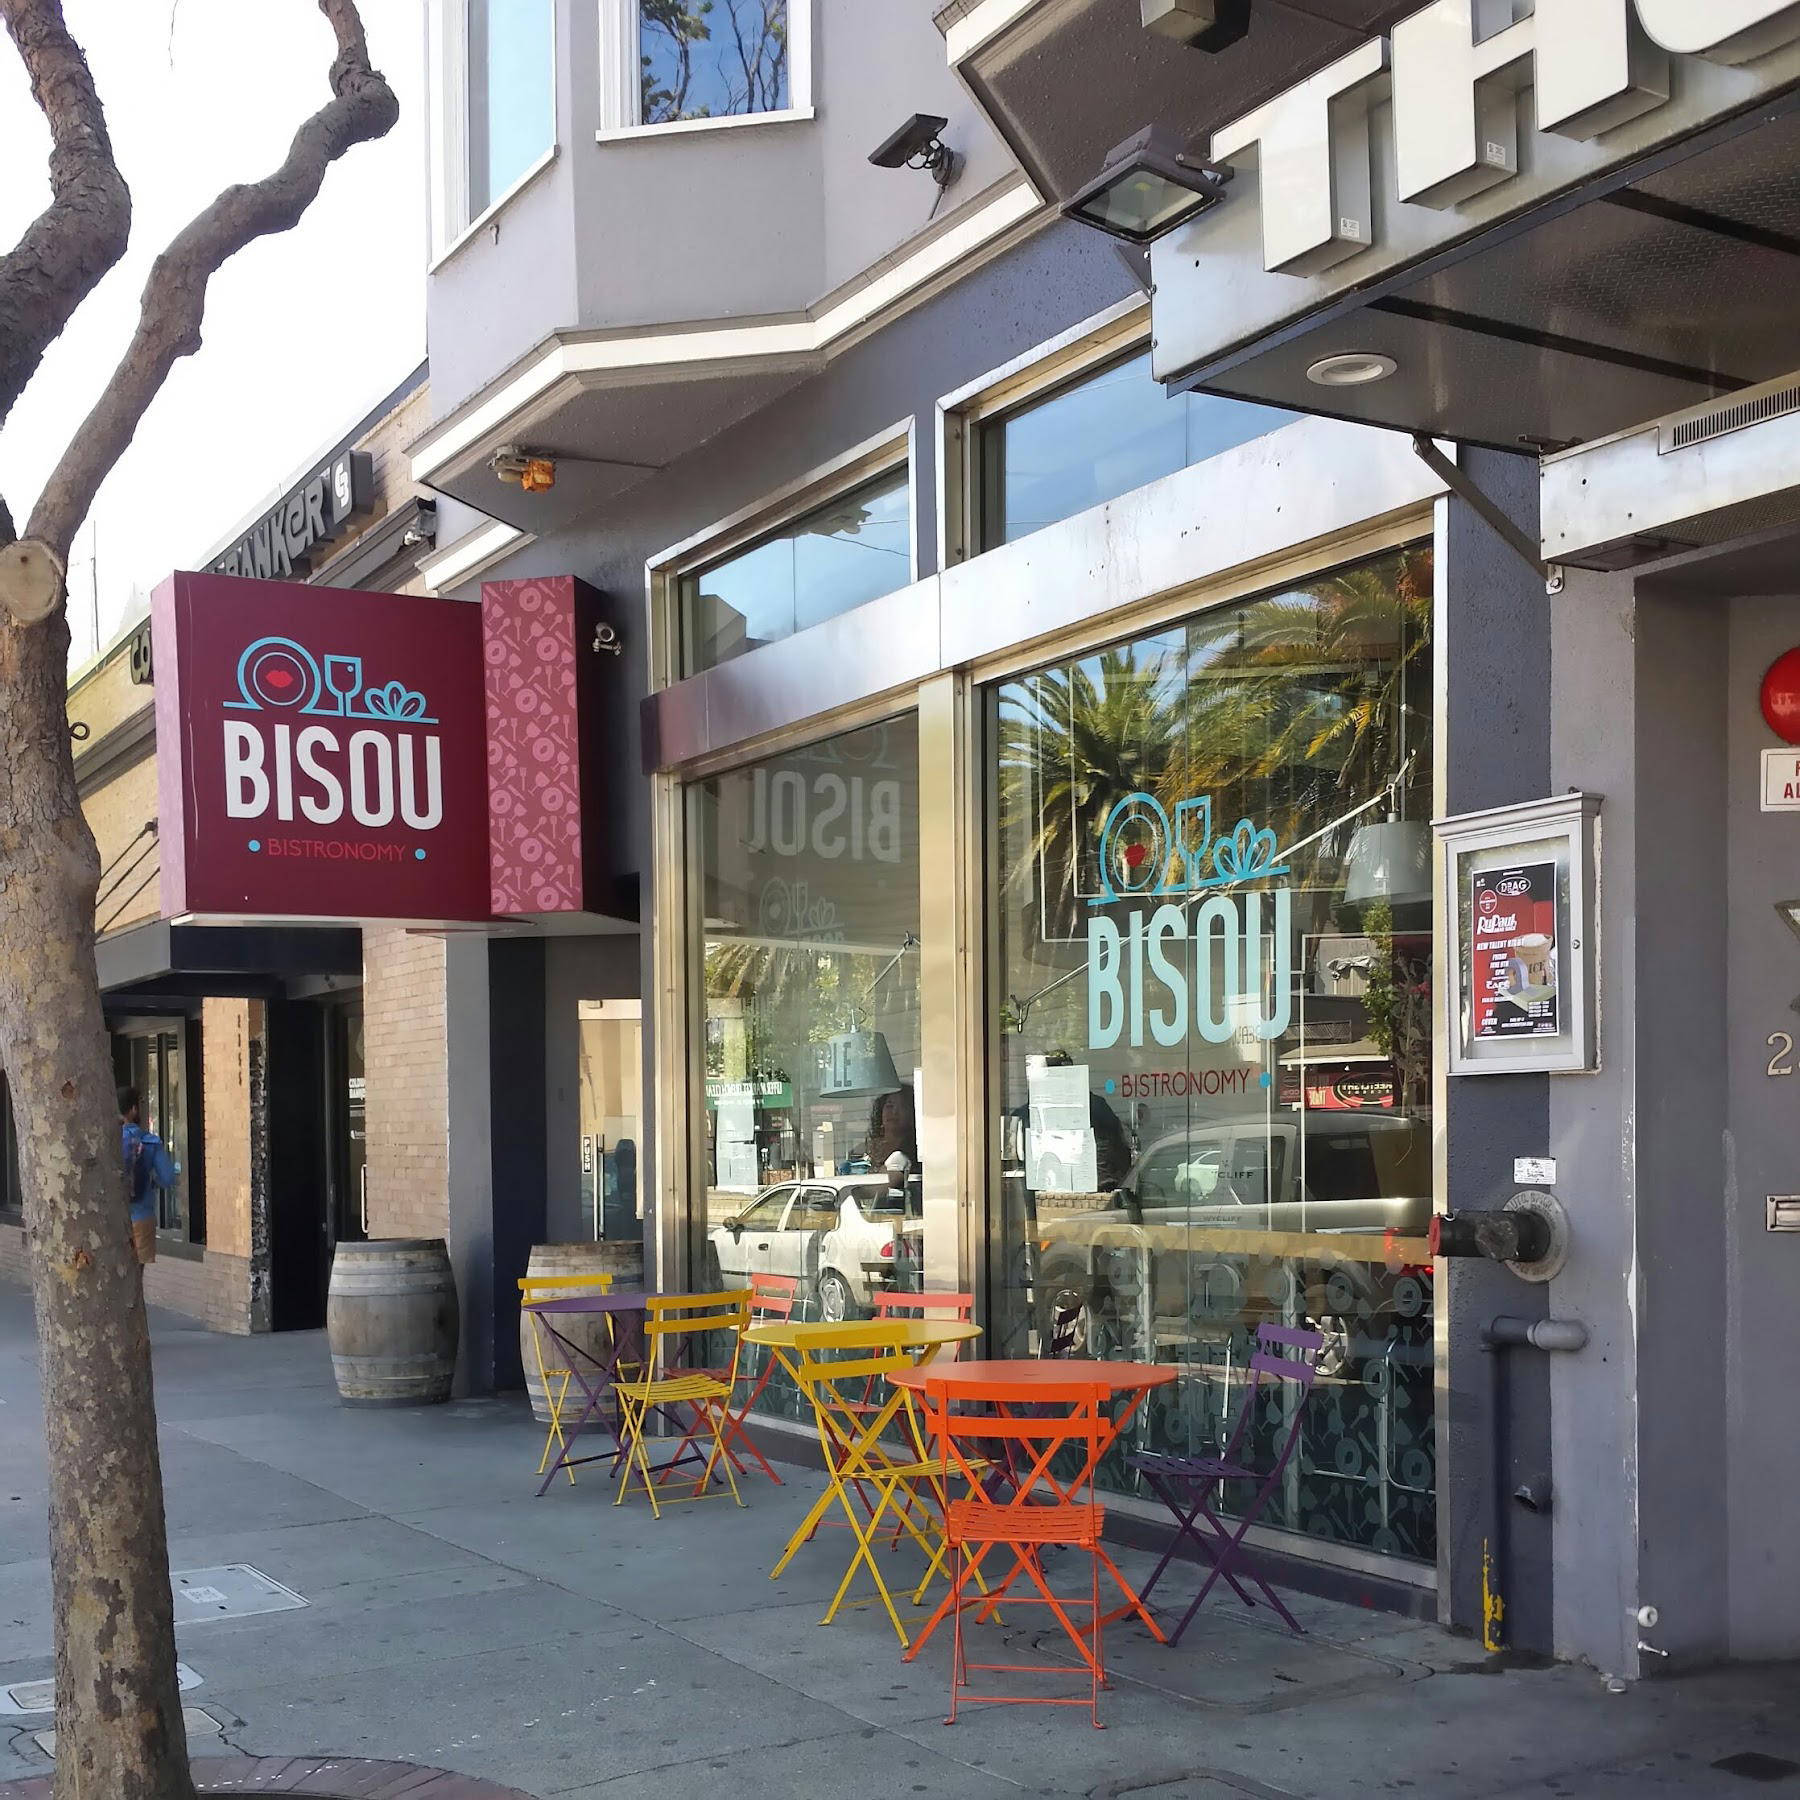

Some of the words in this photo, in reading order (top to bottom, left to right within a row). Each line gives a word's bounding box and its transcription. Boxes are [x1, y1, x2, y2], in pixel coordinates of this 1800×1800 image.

[1210, 0, 1800, 274] TH
[223, 719, 444, 832] BISOU
[267, 836, 407, 863] BISTRONOMY
[1086, 887, 1292, 1051] BISOU
[1121, 1068, 1251, 1098] BISTRONOMY
[583, 1138, 592, 1172] PUSH
